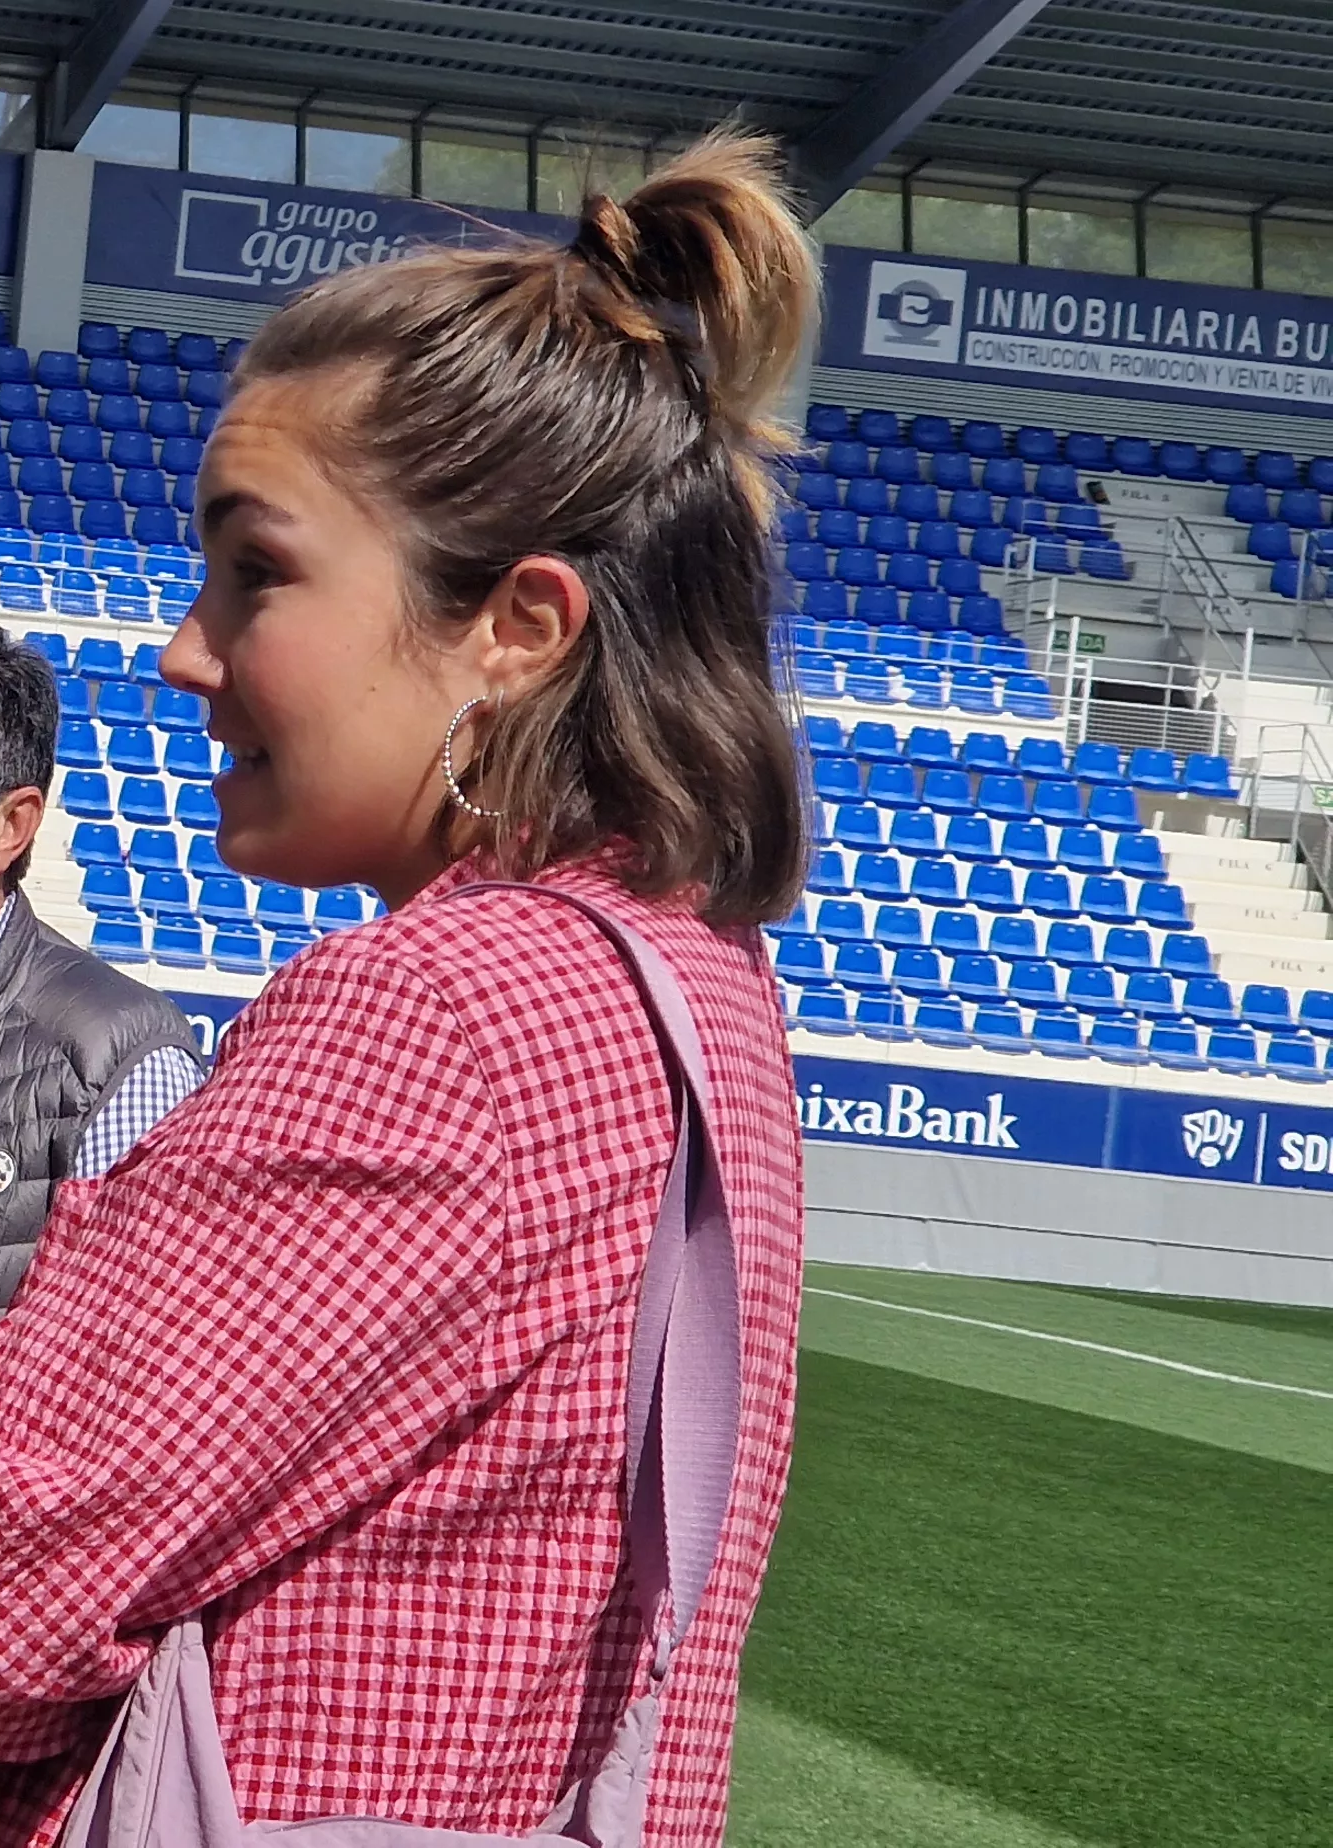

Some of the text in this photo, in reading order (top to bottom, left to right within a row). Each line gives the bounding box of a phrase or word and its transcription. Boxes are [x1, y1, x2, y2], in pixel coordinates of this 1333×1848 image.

[275, 201, 377, 238] grupo
[240, 230, 415, 286] agustí
[976, 287, 1333, 362] INMOBILIARIA BU
[1110, 352, 1209, 385] PROMOCIÓN
[1213, 363, 1225, 386] Y
[1228, 365, 1279, 391] VENTA
[1283, 371, 1306, 395] DE
[1218, 858, 1250, 870] FILA
[1245, 908, 1276, 920] FILA
[1270, 960, 1302, 973] FILA
[1277, 1131, 1333, 1174] SD
